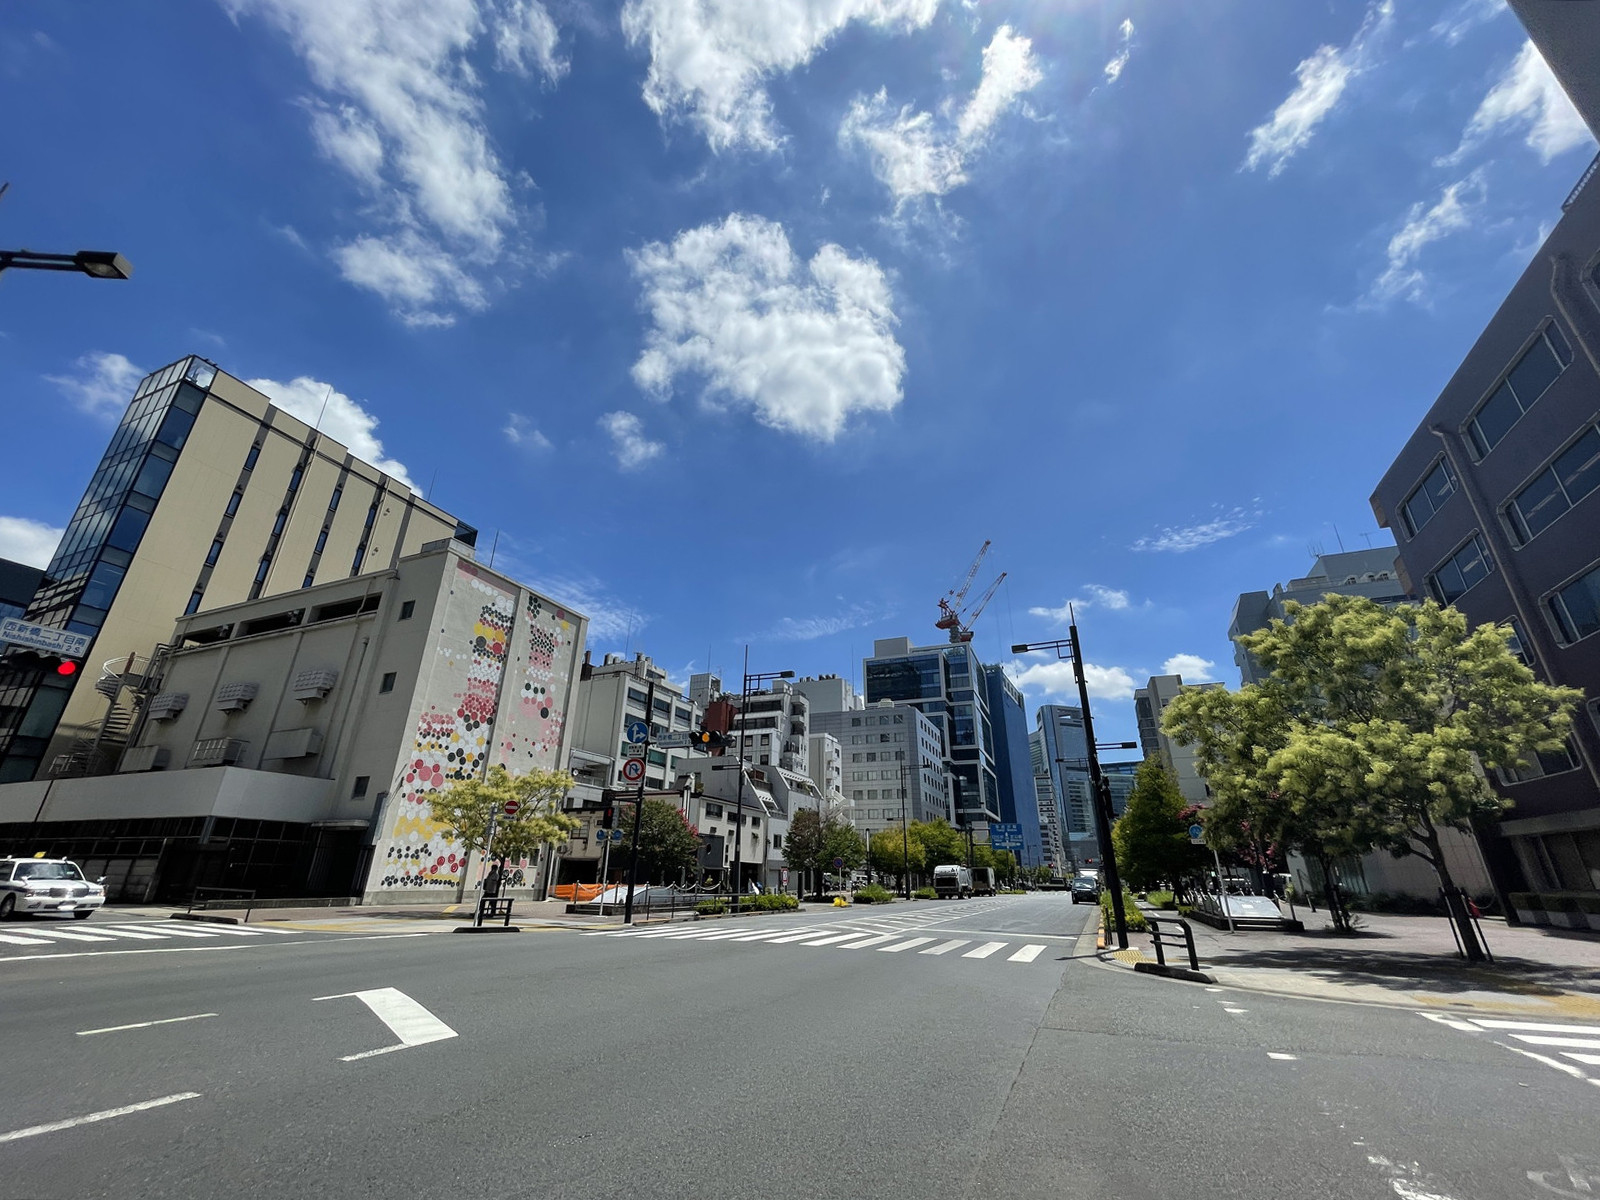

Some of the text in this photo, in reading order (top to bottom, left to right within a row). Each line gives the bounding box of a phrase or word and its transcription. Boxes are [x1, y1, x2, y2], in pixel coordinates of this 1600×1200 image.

[2, 631, 64, 650] Nishishinbashi
[4, 621, 87, 648] 西新橋二丁目南
